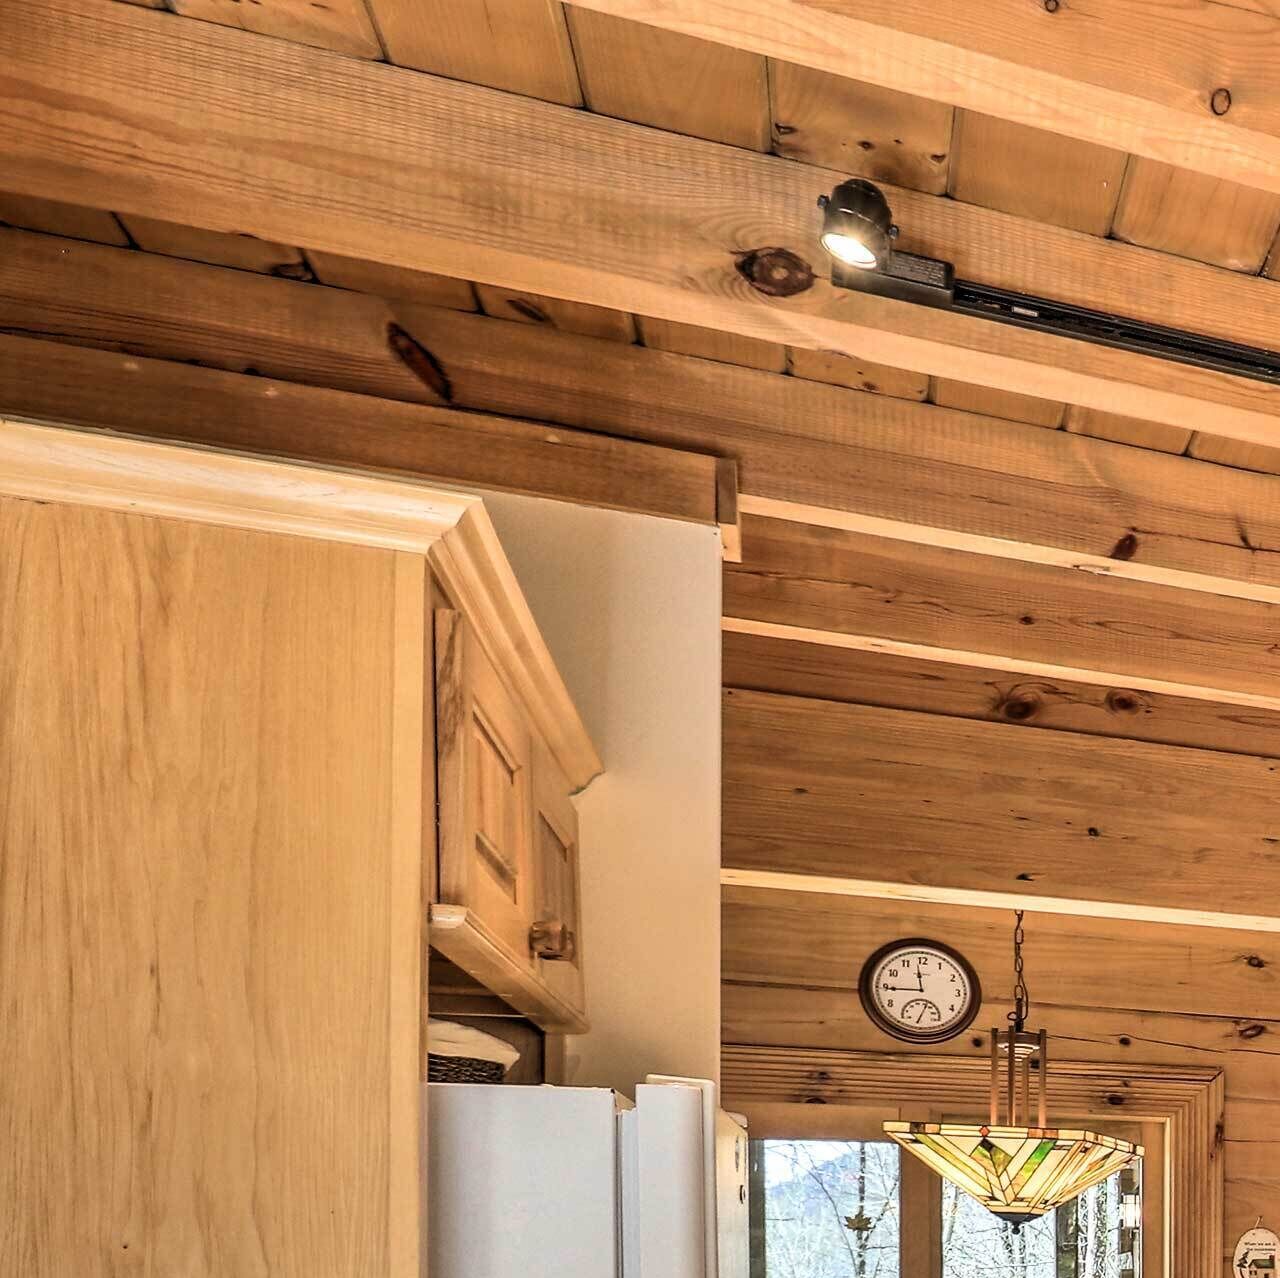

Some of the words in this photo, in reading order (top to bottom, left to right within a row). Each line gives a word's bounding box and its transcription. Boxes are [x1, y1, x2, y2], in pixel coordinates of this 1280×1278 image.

[902, 959, 910, 968] 11
[918, 957, 928, 966] 12
[938, 962, 942, 970] 1
[888, 969, 898, 977] 10
[950, 974, 956, 982] 2
[883, 983, 889, 991] 9
[955, 989, 961, 997] 3
[887, 999, 894, 1008] 8
[949, 1004, 954, 1012] 4
